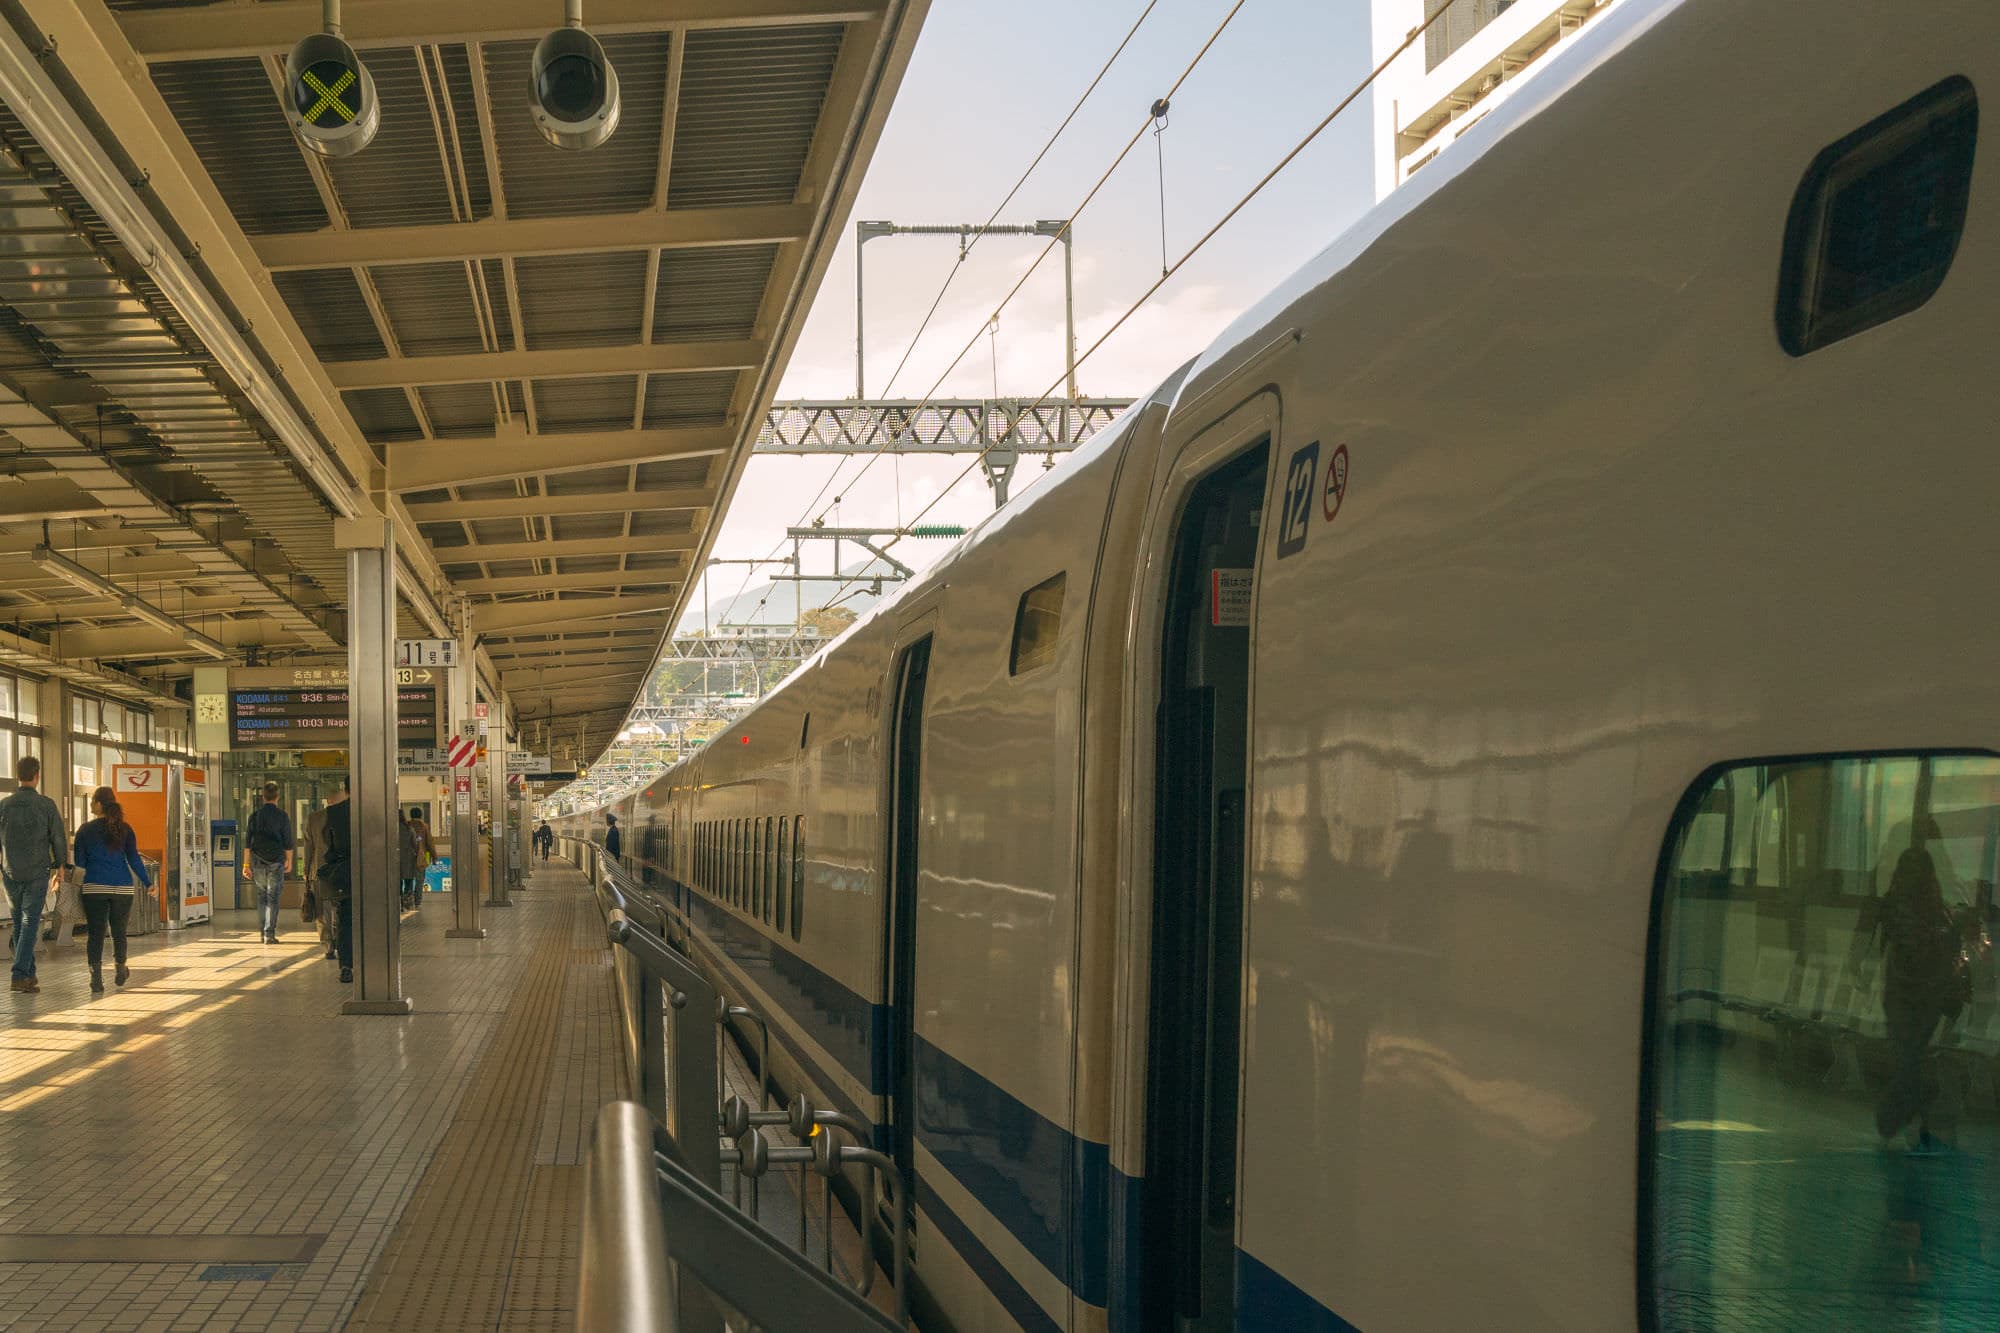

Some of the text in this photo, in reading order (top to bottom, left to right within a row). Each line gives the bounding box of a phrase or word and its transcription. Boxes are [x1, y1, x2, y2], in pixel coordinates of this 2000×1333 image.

[1284, 458, 1313, 544] 12
[398, 671, 411, 683] 13
[236, 694, 270, 703] KODAMA
[301, 694, 323, 702] 9:36
[236, 719, 270, 728] KODAMA
[296, 719, 323, 727] 10:03
